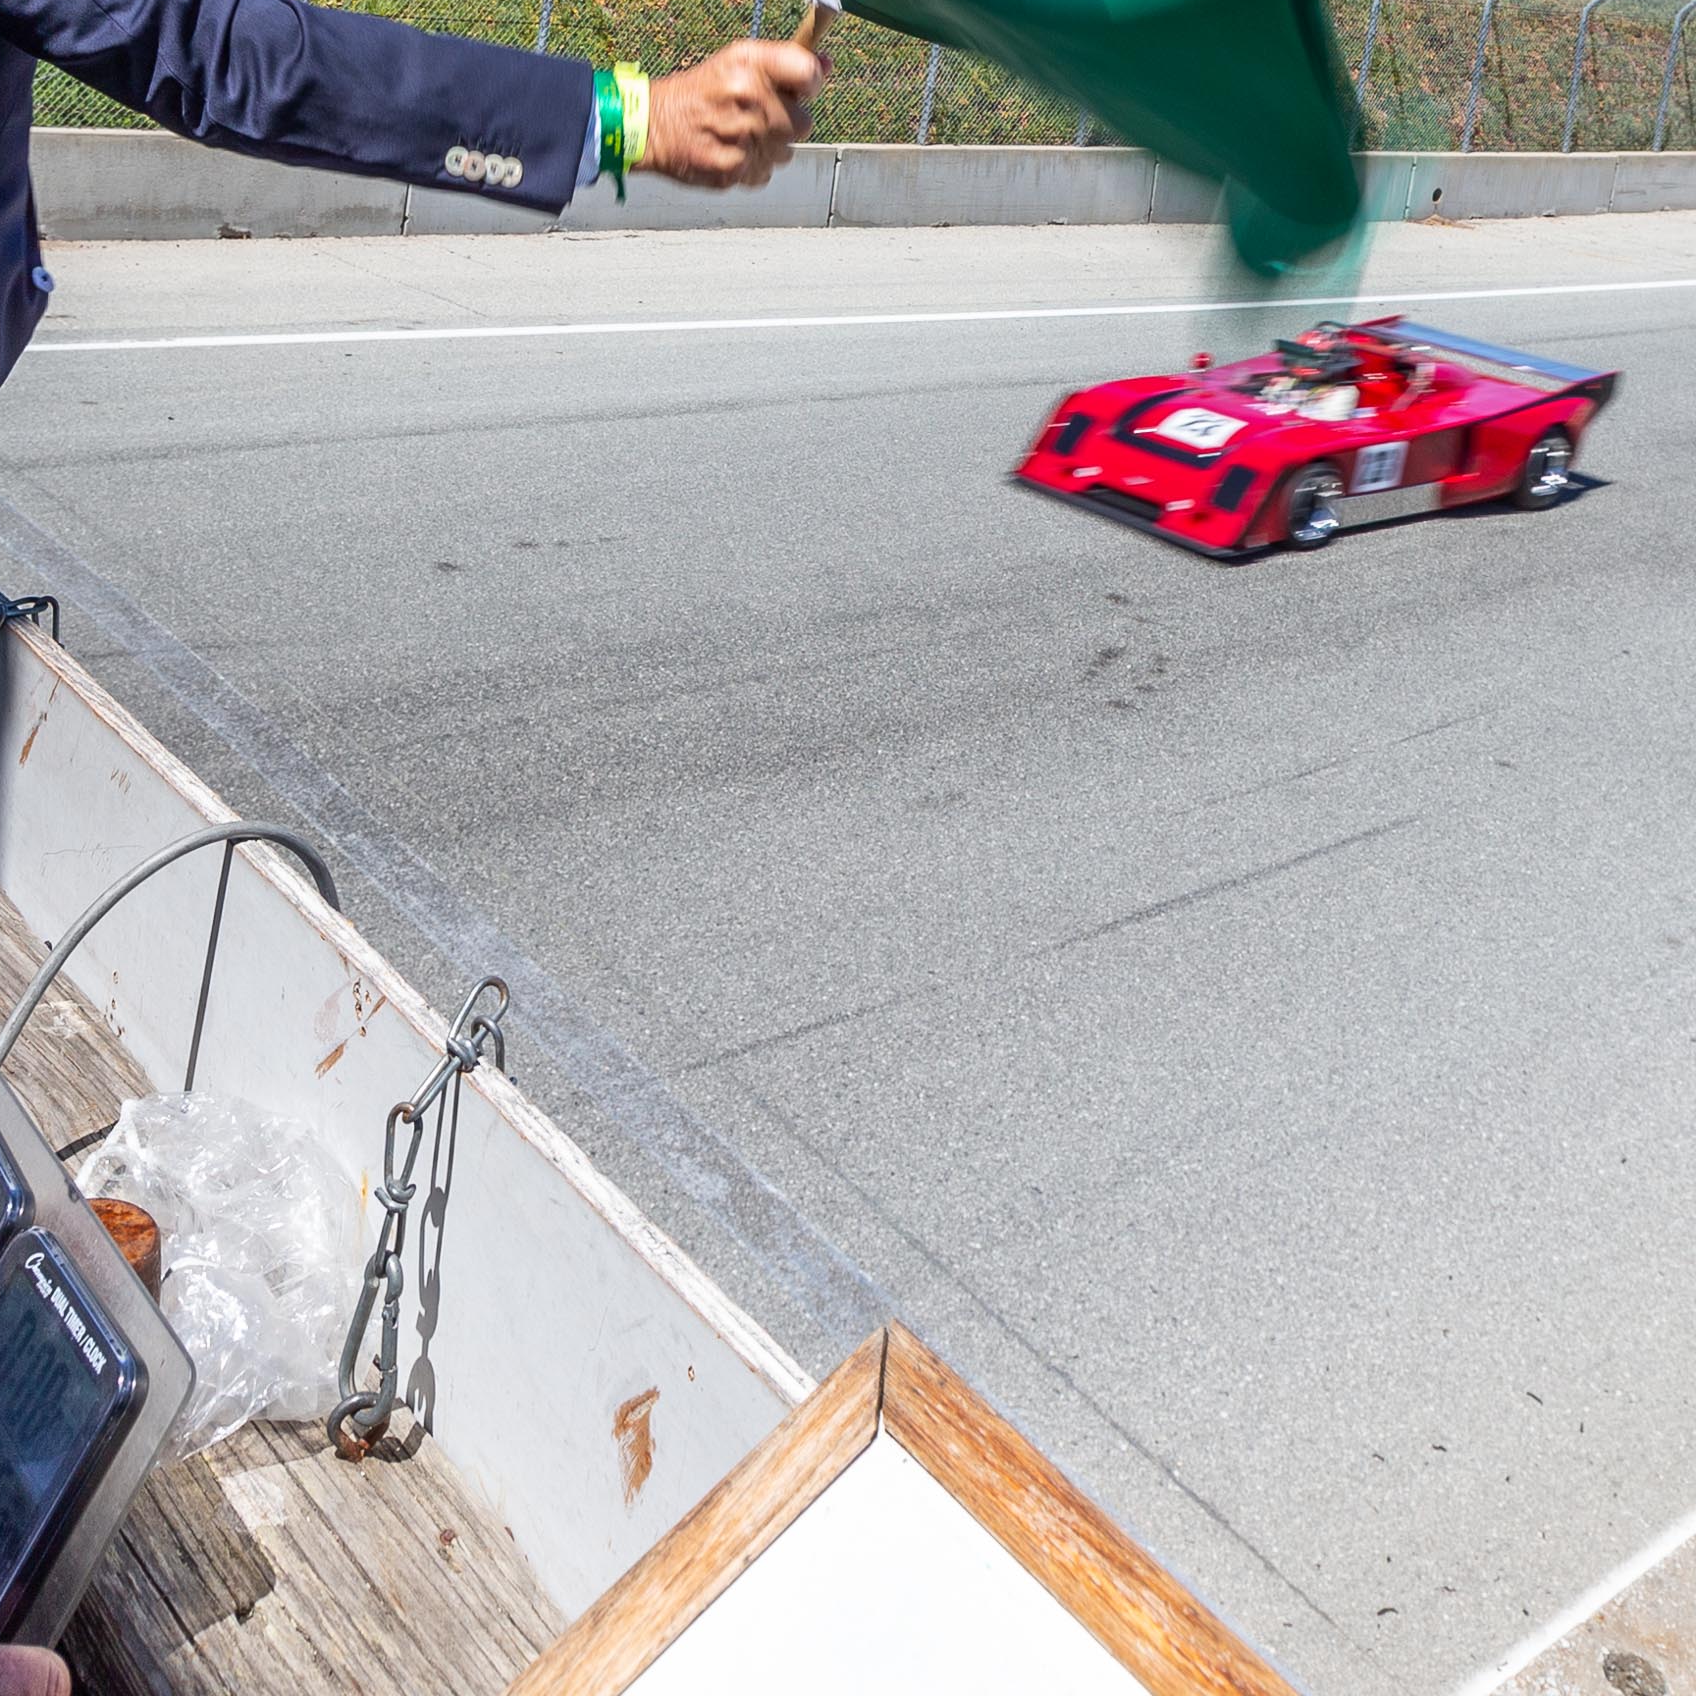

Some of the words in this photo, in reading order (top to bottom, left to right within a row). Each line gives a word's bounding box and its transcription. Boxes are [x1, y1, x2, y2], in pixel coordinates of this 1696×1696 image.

[51, 1286, 69, 1317] DUAL
[64, 1306, 87, 1343] TIMER
[82, 1337, 108, 1375] CLOCK
